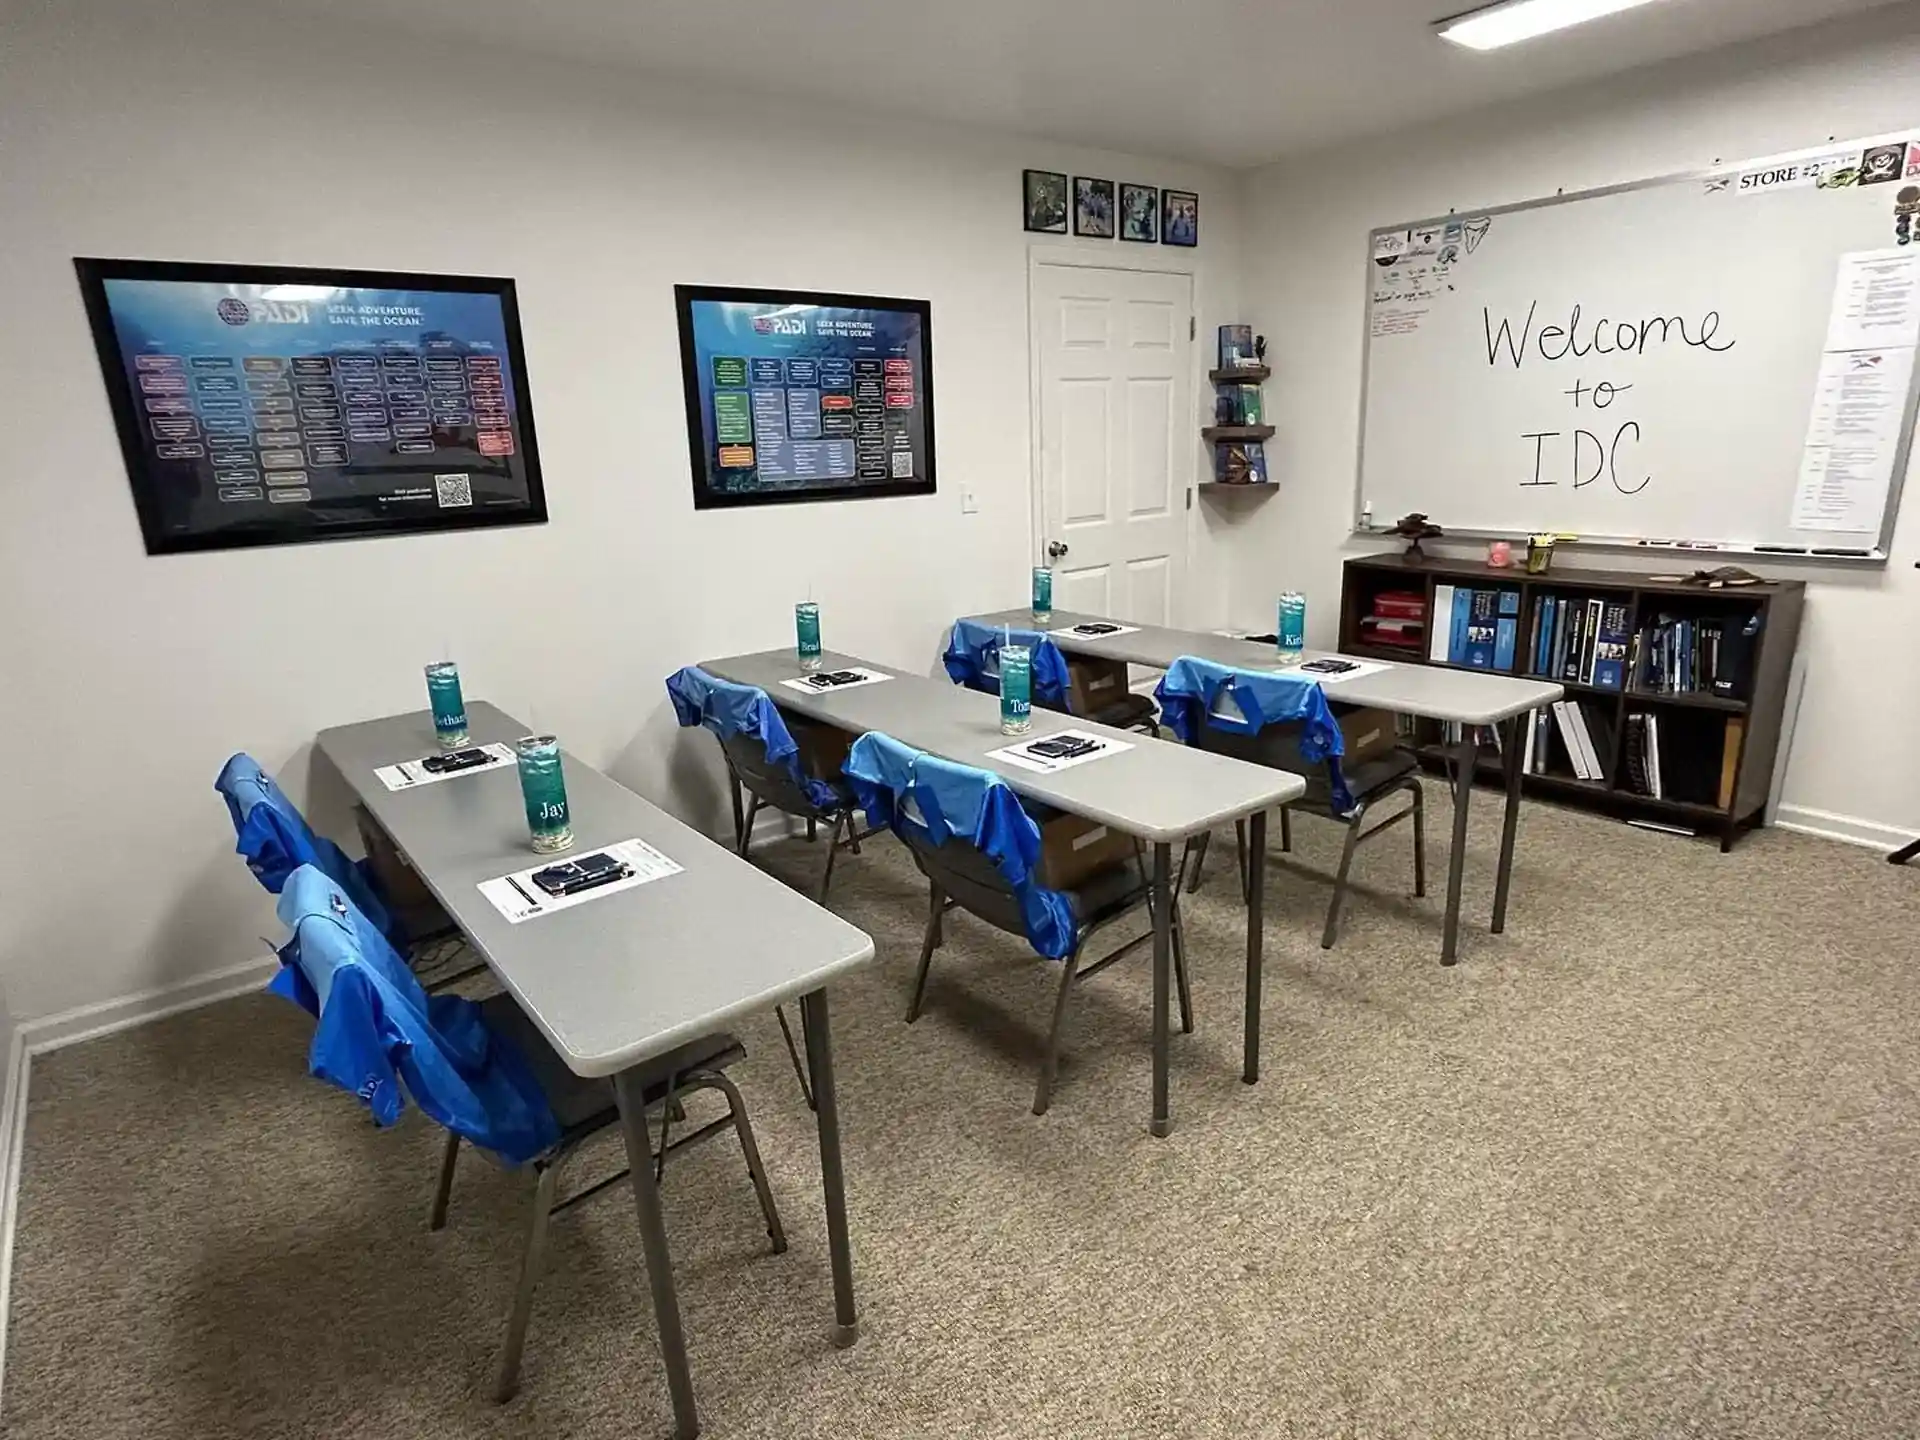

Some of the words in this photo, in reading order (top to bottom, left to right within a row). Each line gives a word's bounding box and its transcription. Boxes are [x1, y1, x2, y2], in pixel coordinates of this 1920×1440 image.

[1739, 166, 1799, 190] STORE
[252, 300, 310, 325] PADI
[328, 304, 355, 315] SEEK
[330, 315, 356, 325] SAVE
[360, 316, 381, 326] THE
[773, 319, 807, 335] PADI
[1483, 299, 1736, 369] Welcome
[1564, 379, 1634, 409] to
[1519, 421, 1651, 495] IDC
[539, 801, 565, 819] Jay
